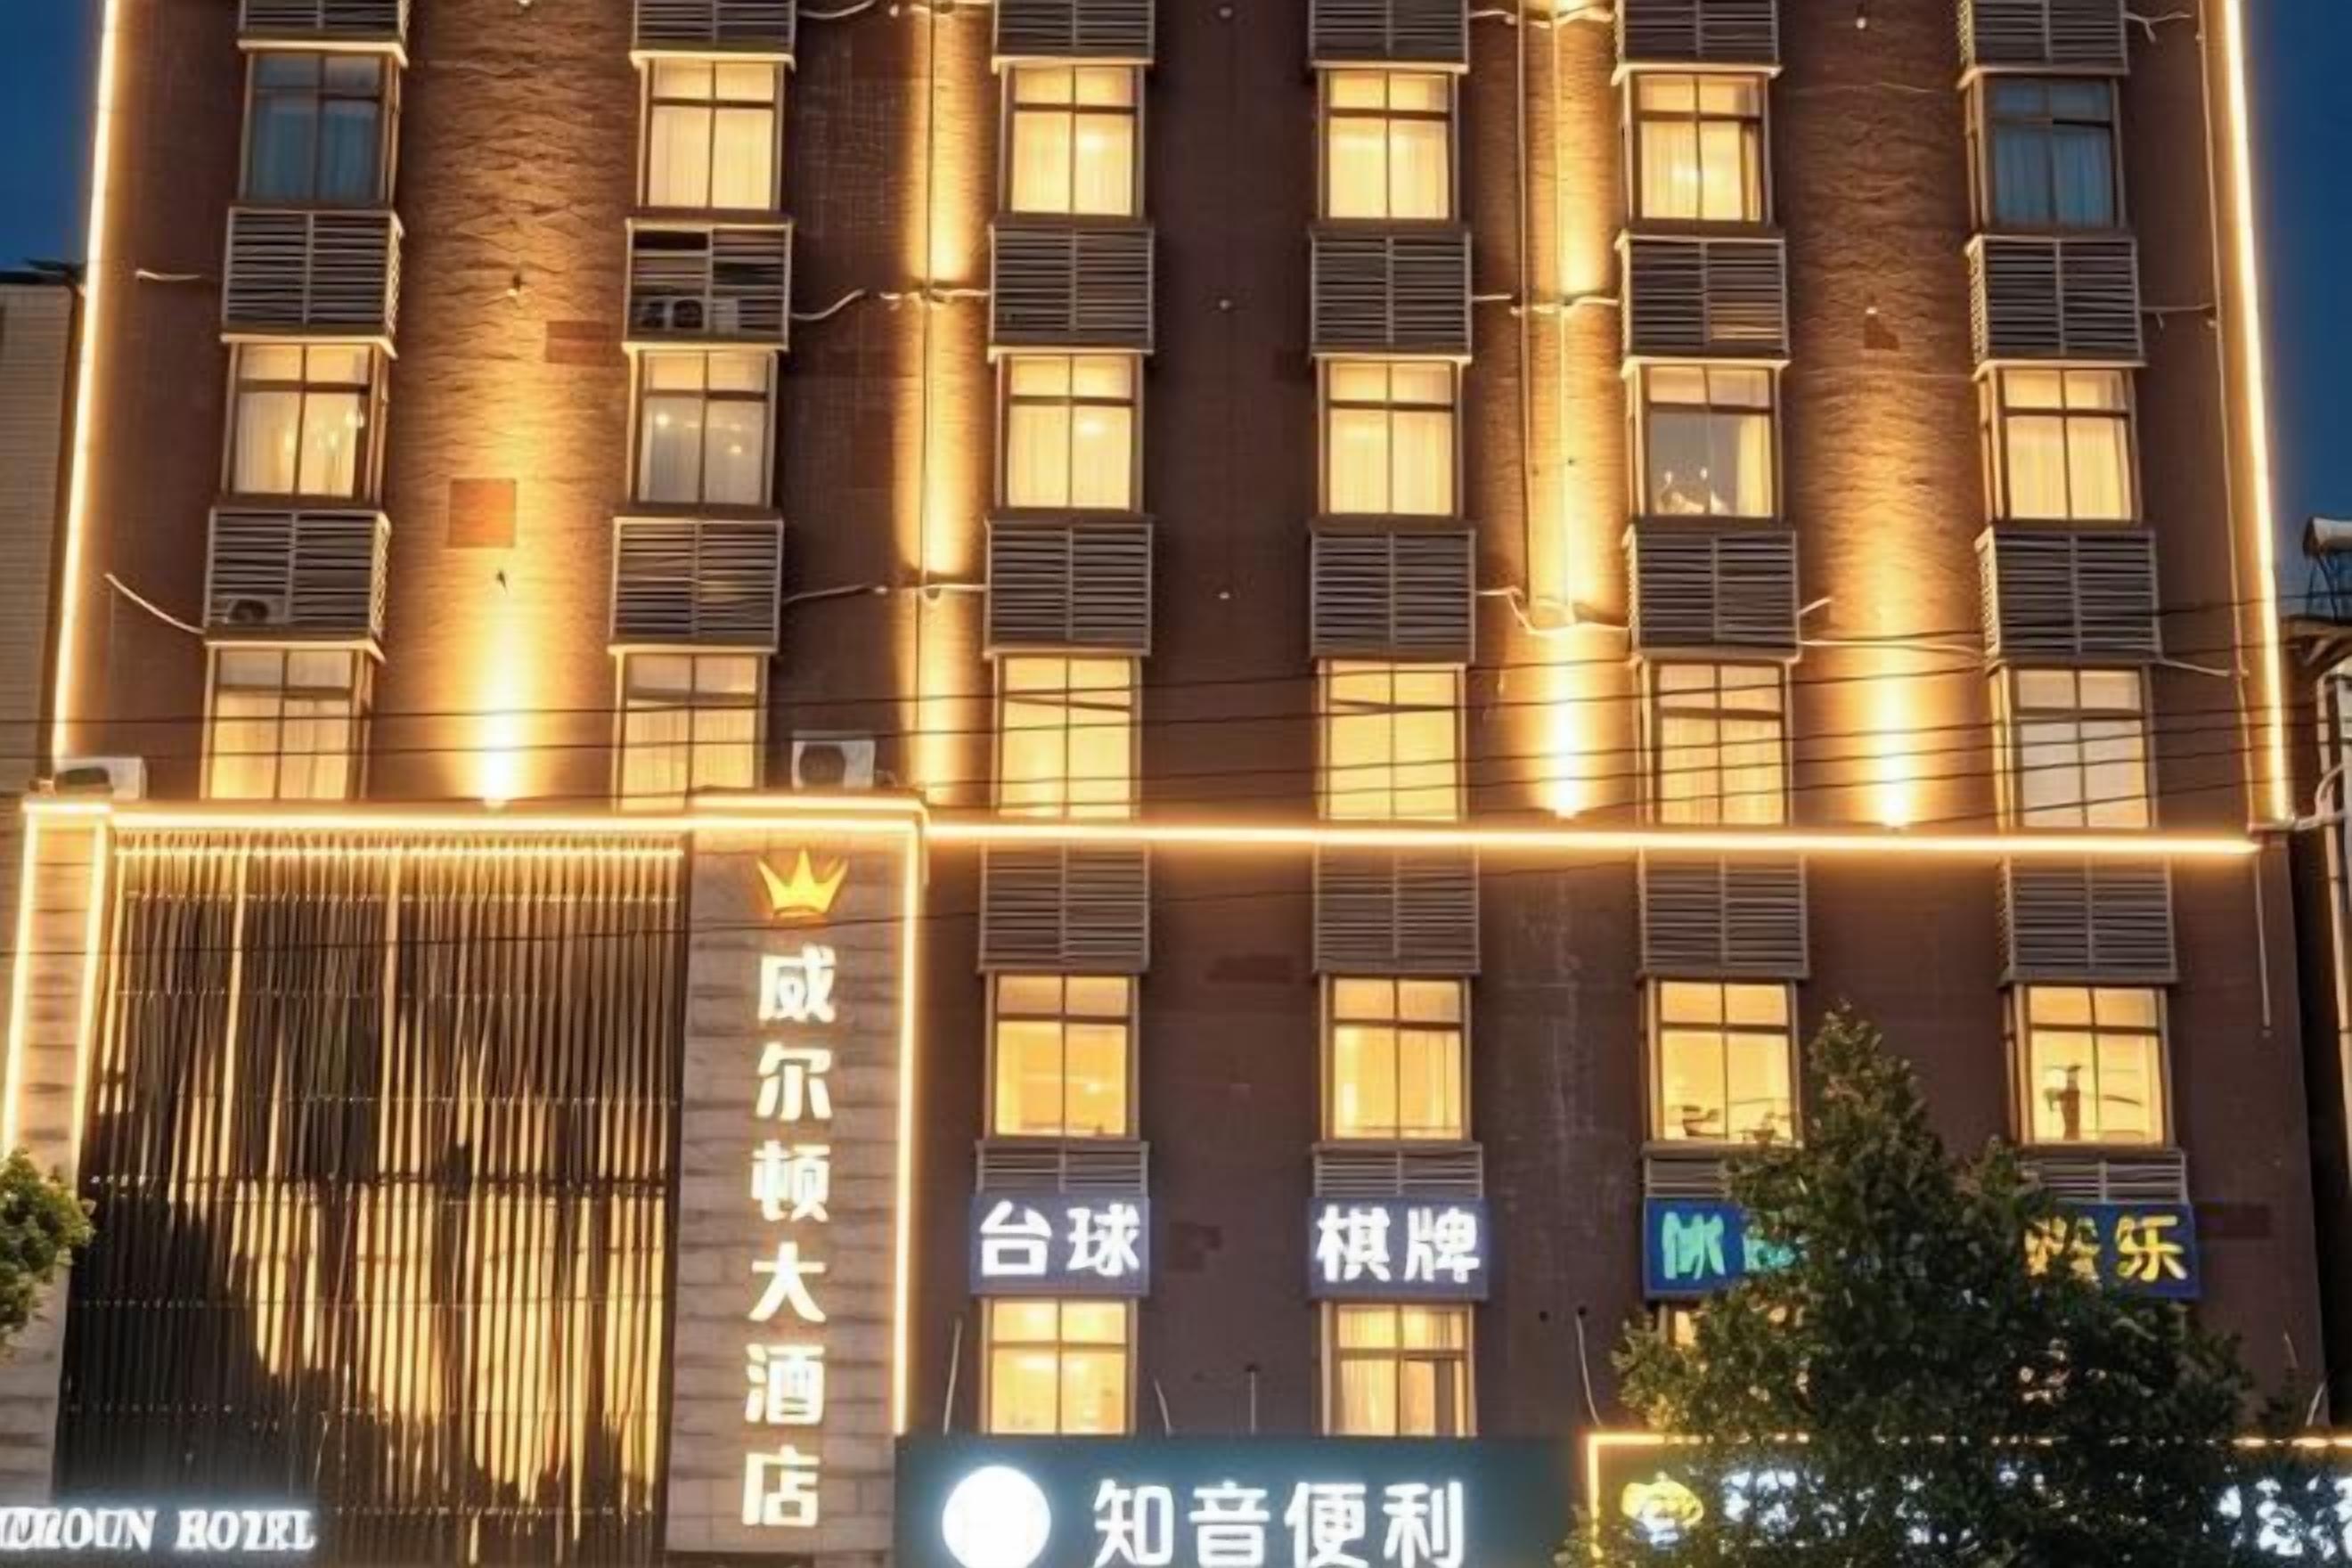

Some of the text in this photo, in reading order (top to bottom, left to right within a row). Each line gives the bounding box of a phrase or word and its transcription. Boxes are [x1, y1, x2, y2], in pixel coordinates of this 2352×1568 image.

[740, 943, 837, 1529] 威尔顿大酒店
[979, 1200, 1141, 1278] 台球
[1315, 1204, 1481, 1283] 棋牌
[1091, 1478, 1466, 1568] 知音便利
